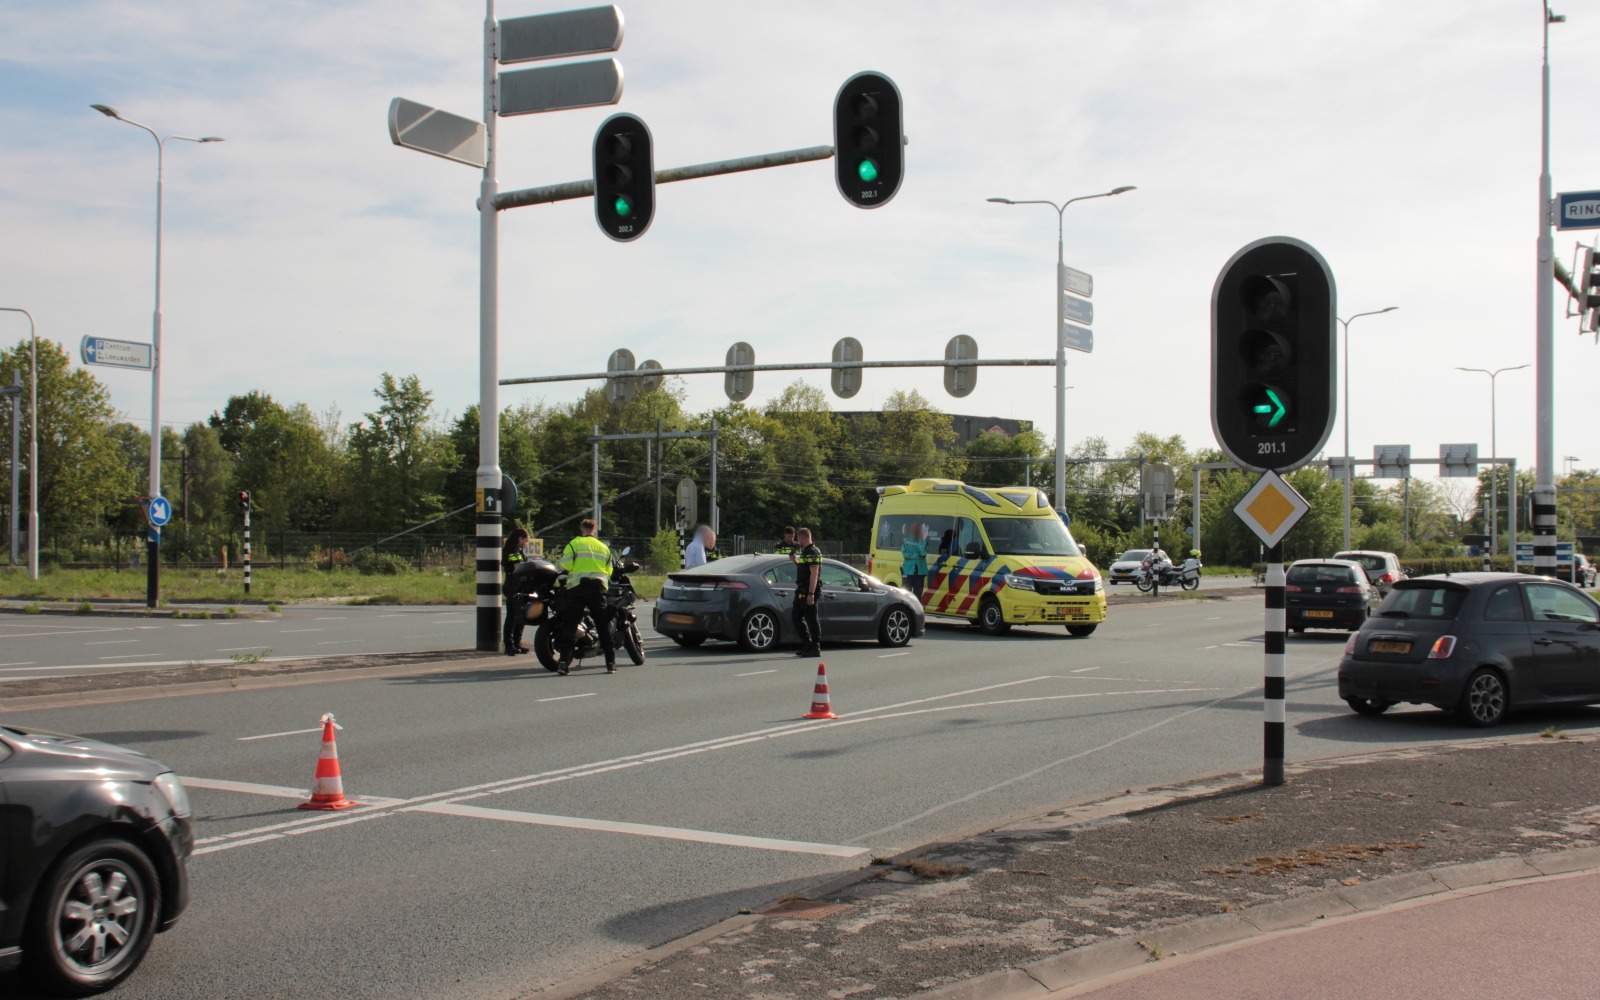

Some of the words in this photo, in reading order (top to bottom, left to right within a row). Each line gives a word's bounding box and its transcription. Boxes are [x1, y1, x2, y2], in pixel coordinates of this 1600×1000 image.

[861, 190, 878, 198] 202.1
[618, 225, 633, 233] 202.2
[105, 342, 132, 351] Centrum
[105, 354, 141, 363] Leeuwarden
[1257, 441, 1286, 454] 201.1
